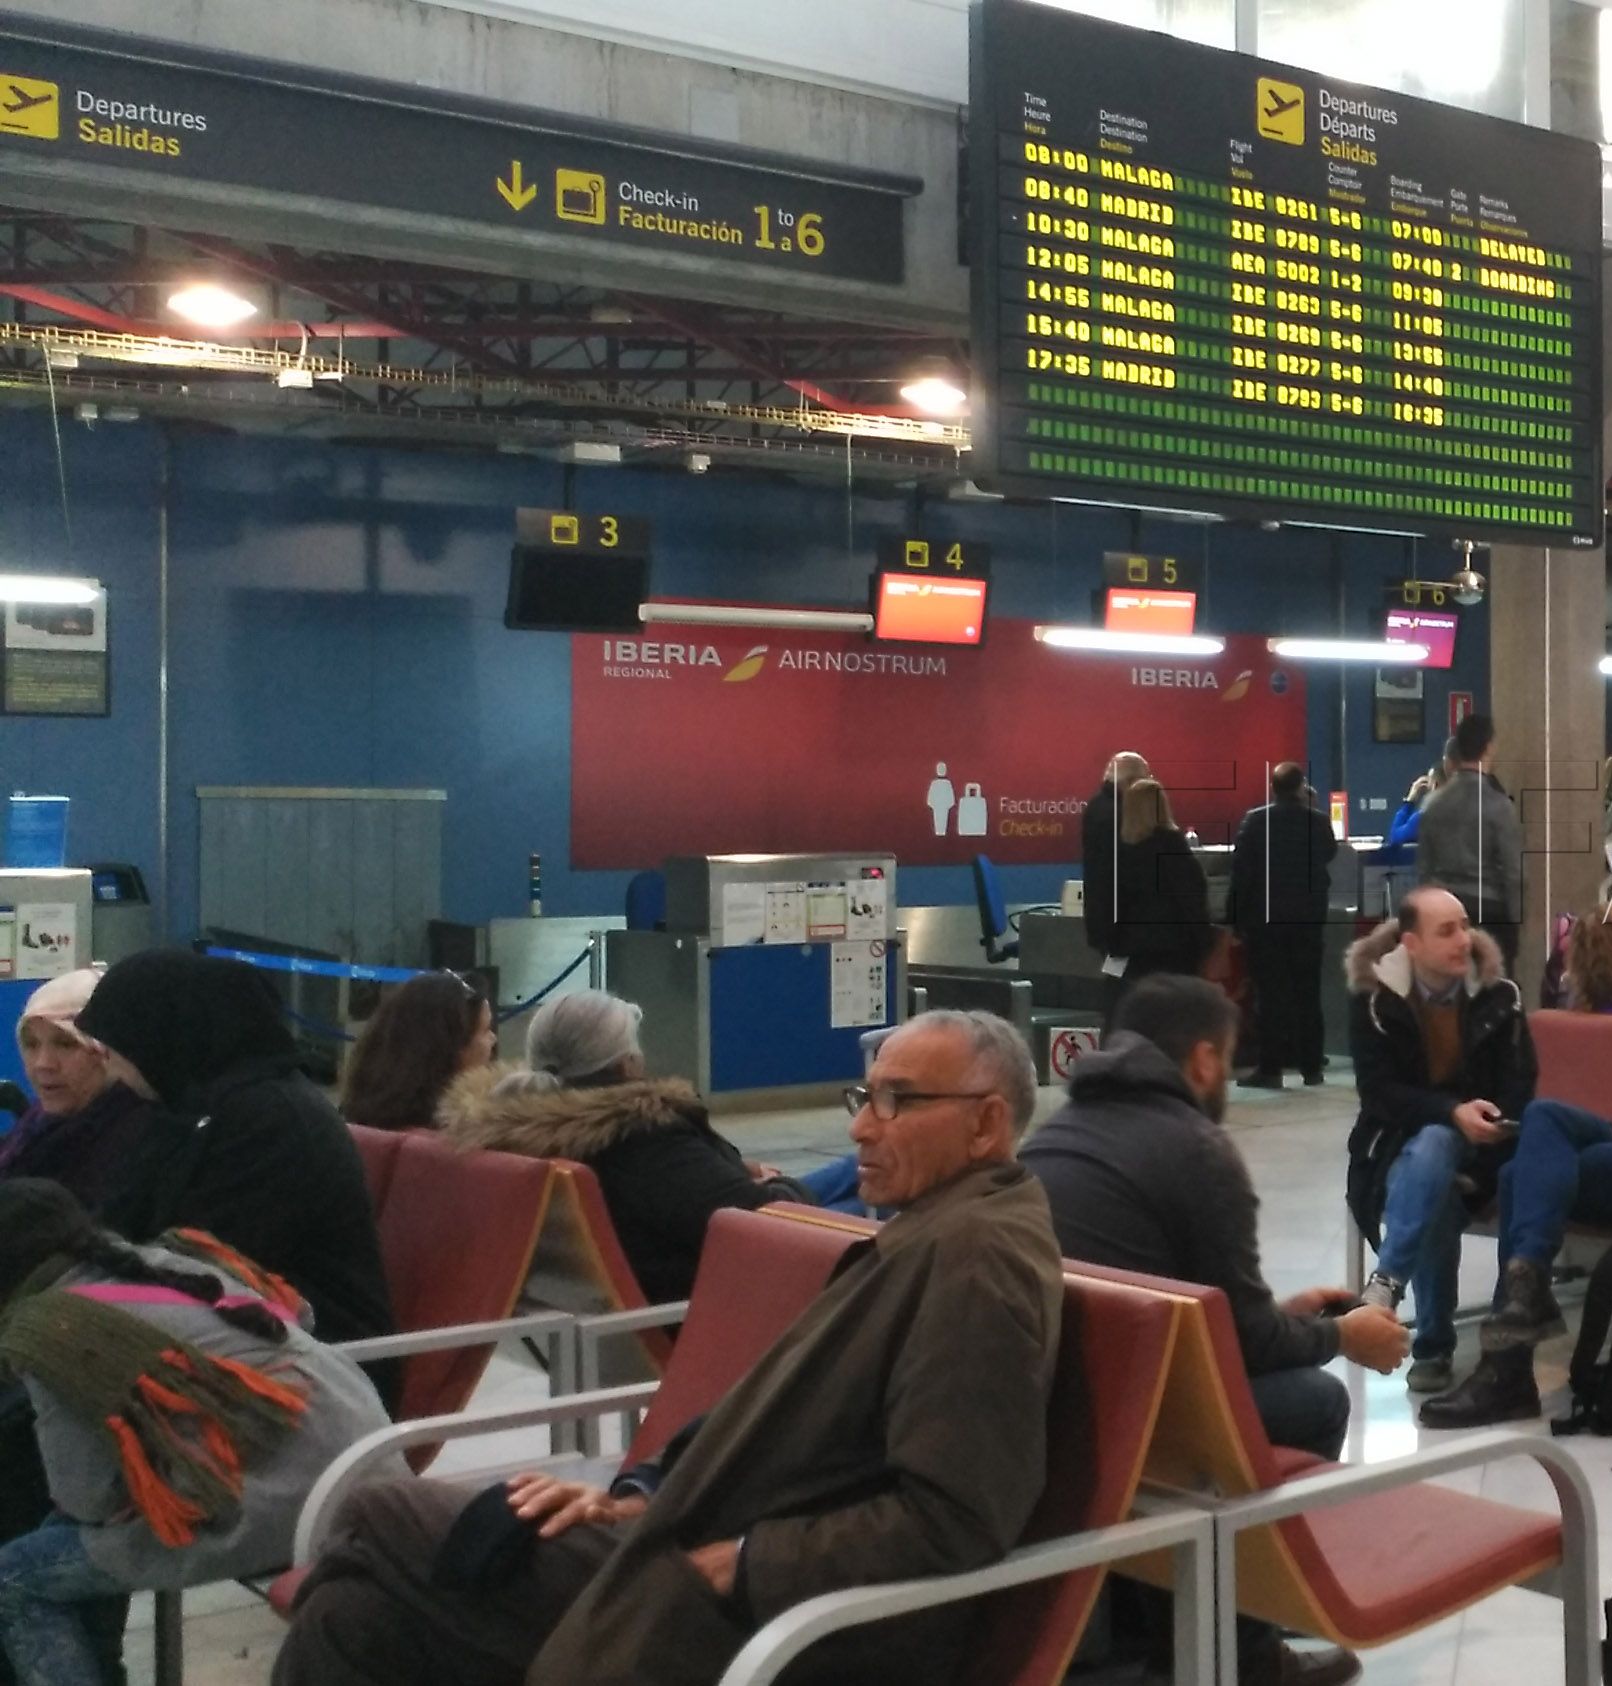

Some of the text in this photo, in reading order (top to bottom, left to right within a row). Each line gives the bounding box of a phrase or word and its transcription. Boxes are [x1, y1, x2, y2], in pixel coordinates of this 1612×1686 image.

[76, 90, 207, 132] Departures
[1025, 92, 1047, 107] Time
[1025, 107, 1051, 122] Heure
[1319, 88, 1398, 125] Departures
[1100, 109, 1148, 130] Destination
[1100, 123, 1148, 143] Destination
[1319, 112, 1376, 142] Départs
[78, 118, 181, 157] Salidas
[1230, 139, 1253, 154] Flight
[1320, 136, 1378, 167] Salidas
[1328, 161, 1358, 177] Counter
[618, 181, 699, 212] Check-in
[1025, 142, 1089, 173] 08:00
[1100, 159, 1174, 191] MALAGA
[1231, 187, 1265, 210] IBE
[1329, 207, 1362, 230] 5-6
[1391, 220, 1442, 246] 07:00
[1480, 238, 1546, 266] DELAYED
[618, 205, 743, 246] Facturación
[753, 206, 825, 256] 1 to 6
[1025, 177, 1089, 208] 08:40
[1100, 193, 1174, 225] MADRID
[1231, 219, 1265, 243] IBE
[1329, 239, 1362, 262] 5-6
[1392, 251, 1443, 277] 07:40
[1451, 263, 1462, 281] 2
[1480, 268, 1555, 298] BOARDING
[780, 236, 792, 252] a
[1027, 212, 1443, 307] 10:30 MALAGA AEA 5002 1-2 09:30
[1027, 246, 1089, 275] 12:05
[1101, 259, 1175, 290] MALAGA
[1232, 282, 1266, 306] IBE
[1330, 300, 1362, 323] 5-6
[1393, 311, 1443, 337] 11:05
[1028, 279, 1090, 308] 14:55
[1101, 292, 1175, 322] MALAGA
[1232, 314, 1266, 338] IBE
[1330, 330, 1363, 353] 5-6
[1394, 341, 1443, 366] 13:55
[1027, 313, 1090, 342] 15:40
[1101, 326, 1175, 355] MALAGA
[1232, 346, 1266, 369] IBE
[1330, 362, 1363, 384] 5-6
[1394, 372, 1443, 396] 14:40
[1028, 348, 1090, 376] 17:35
[1102, 360, 1175, 388] MADRID
[1232, 379, 1267, 402] IBE
[1331, 393, 1363, 415] 5-6
[1394, 402, 1443, 426] 16:35
[600, 517, 619, 547] 3
[945, 543, 964, 570] 4
[1163, 558, 1178, 585] 5
[603, 640, 723, 668] IBERIA
[603, 667, 672, 679] REGIONAL
[1131, 666, 1219, 690] IBERIA
[1000, 820, 1064, 836] Check-in
